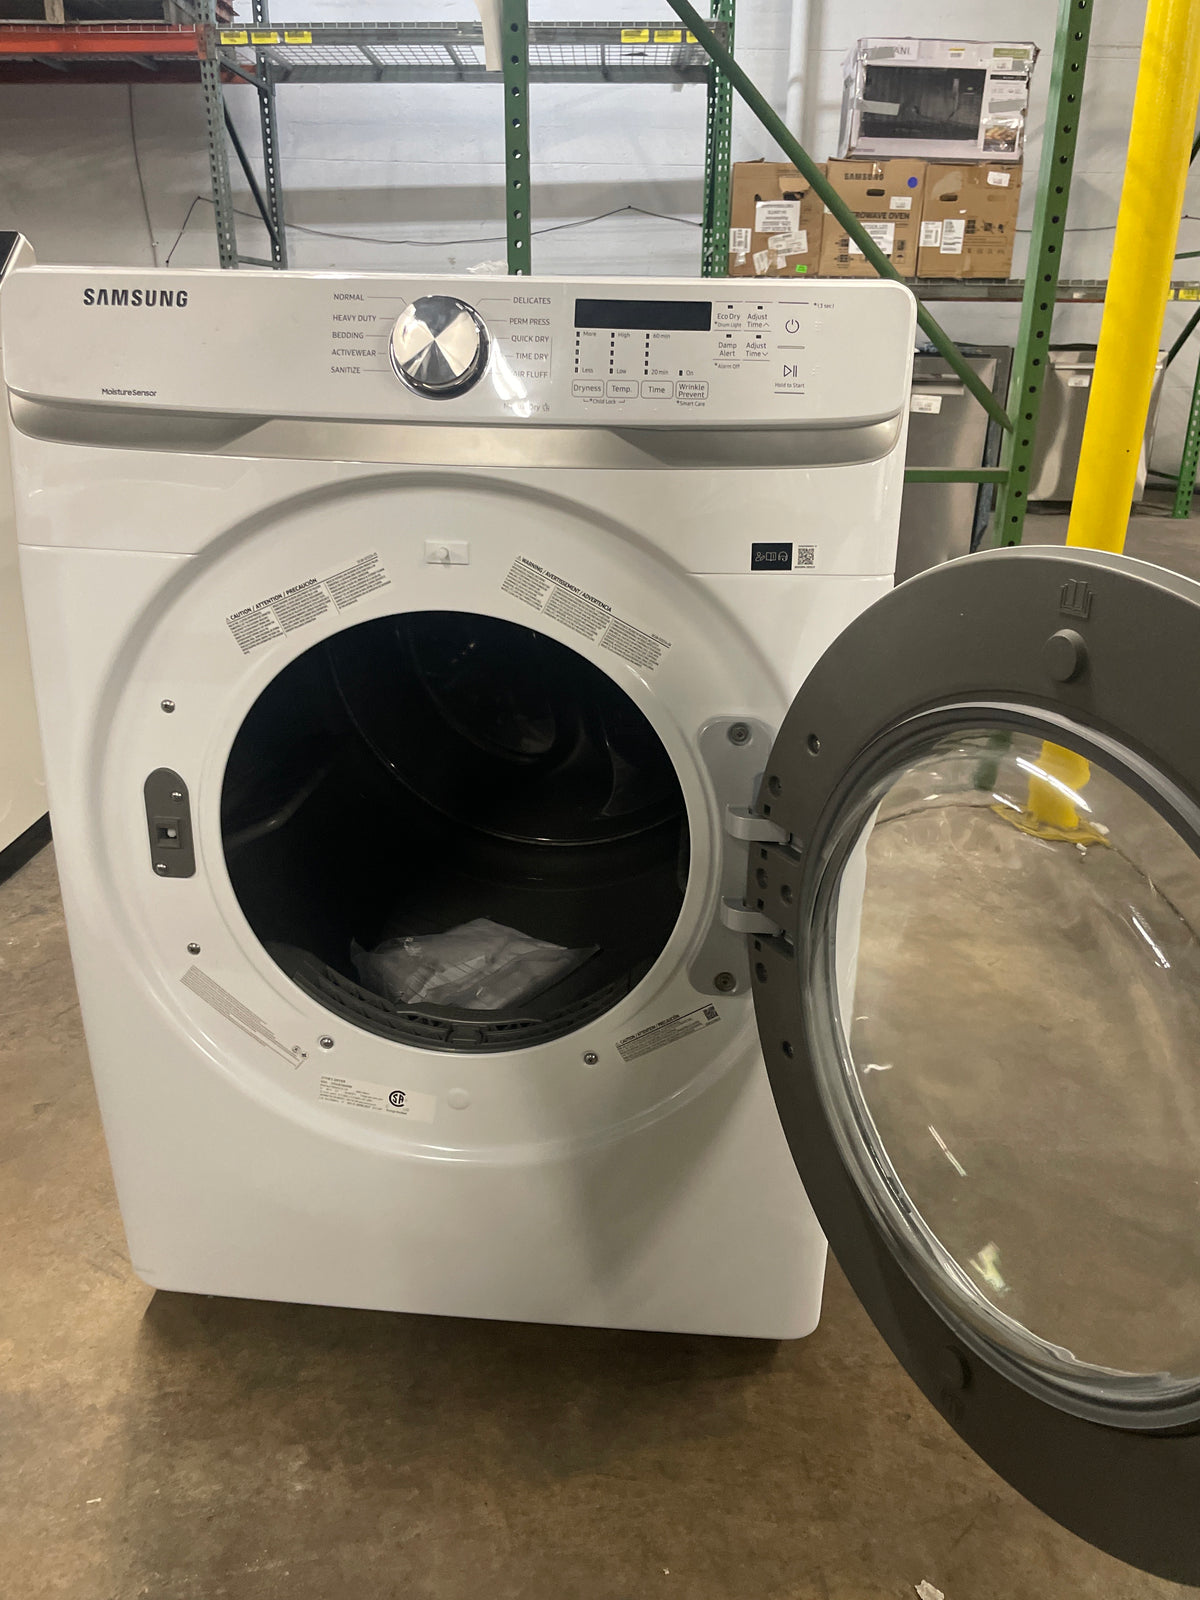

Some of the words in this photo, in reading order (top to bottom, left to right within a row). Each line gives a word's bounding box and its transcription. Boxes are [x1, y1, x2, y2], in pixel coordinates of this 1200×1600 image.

[83, 288, 188, 307] SAMSUNG
[333, 293, 364, 301] NORMAL
[513, 297, 551, 305] DELICATES
[332, 314, 356, 322] HEAVY
[357, 314, 376, 322] DUTY
[729, 313, 740, 321] Dry
[747, 313, 768, 321] Adjust
[509, 318, 527, 326] PERM
[529, 318, 550, 326] PRESS
[332, 331, 364, 339] BEDDING
[511, 335, 533, 343] QUICK
[534, 335, 549, 343] DRY
[746, 342, 767, 350] Adjust
[331, 349, 377, 357] ACTIVEWEAR
[515, 352, 532, 360] TIME
[533, 352, 549, 361] DRY
[330, 366, 361, 374] SANITIZE
[526, 371, 548, 379] FLUFF
[573, 385, 602, 393] Dryness
[678, 383, 705, 391] Wrinkle
[521, 557, 544, 573] WARNING
[545, 570, 581, 594] AVERTISSEMENT
[581, 591, 612, 613] ADVERTENCIA
[230, 607, 252, 621] CAUTION
[255, 592, 283, 610] ATTENTION
[285, 577, 318, 596] PRECAUCIÓN
